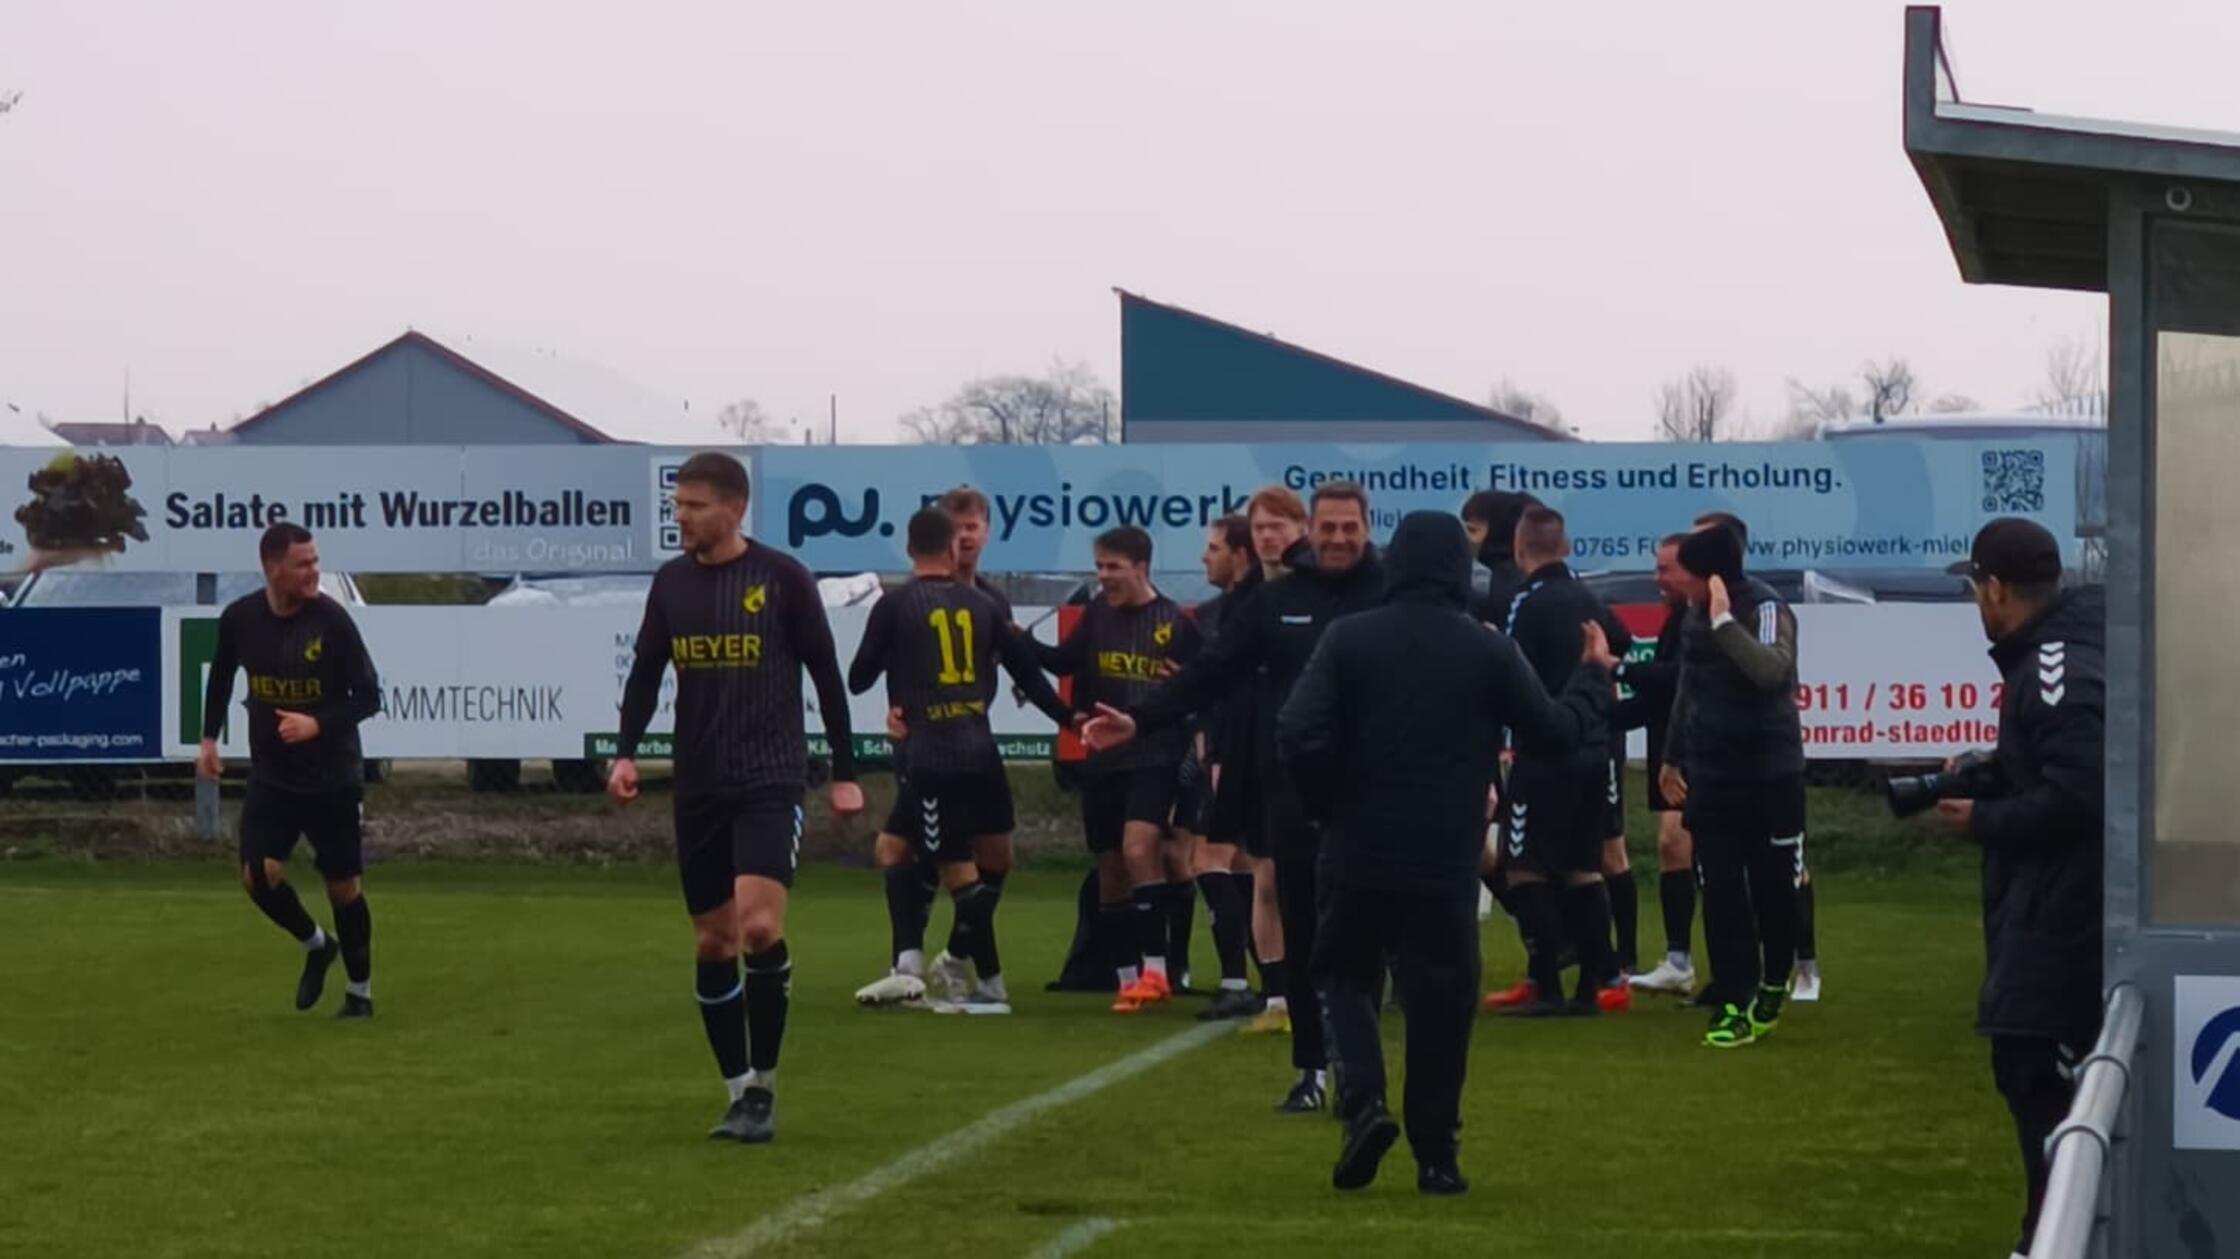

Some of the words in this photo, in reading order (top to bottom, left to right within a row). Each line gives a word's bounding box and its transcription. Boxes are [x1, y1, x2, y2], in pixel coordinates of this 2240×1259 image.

[1490, 464, 1608, 489] Fitness
[1617, 464, 1677, 488] und
[1688, 464, 1842, 494] Erholung.
[166, 492, 287, 529] Salate
[303, 492, 366, 529] mit
[380, 490, 631, 528] Wurzelballen
[929, 608, 976, 684] 11
[14, 669, 141, 701] Vollpappe
[1889, 683, 1926, 711] 36
[1941, 683, 1978, 710] 10
